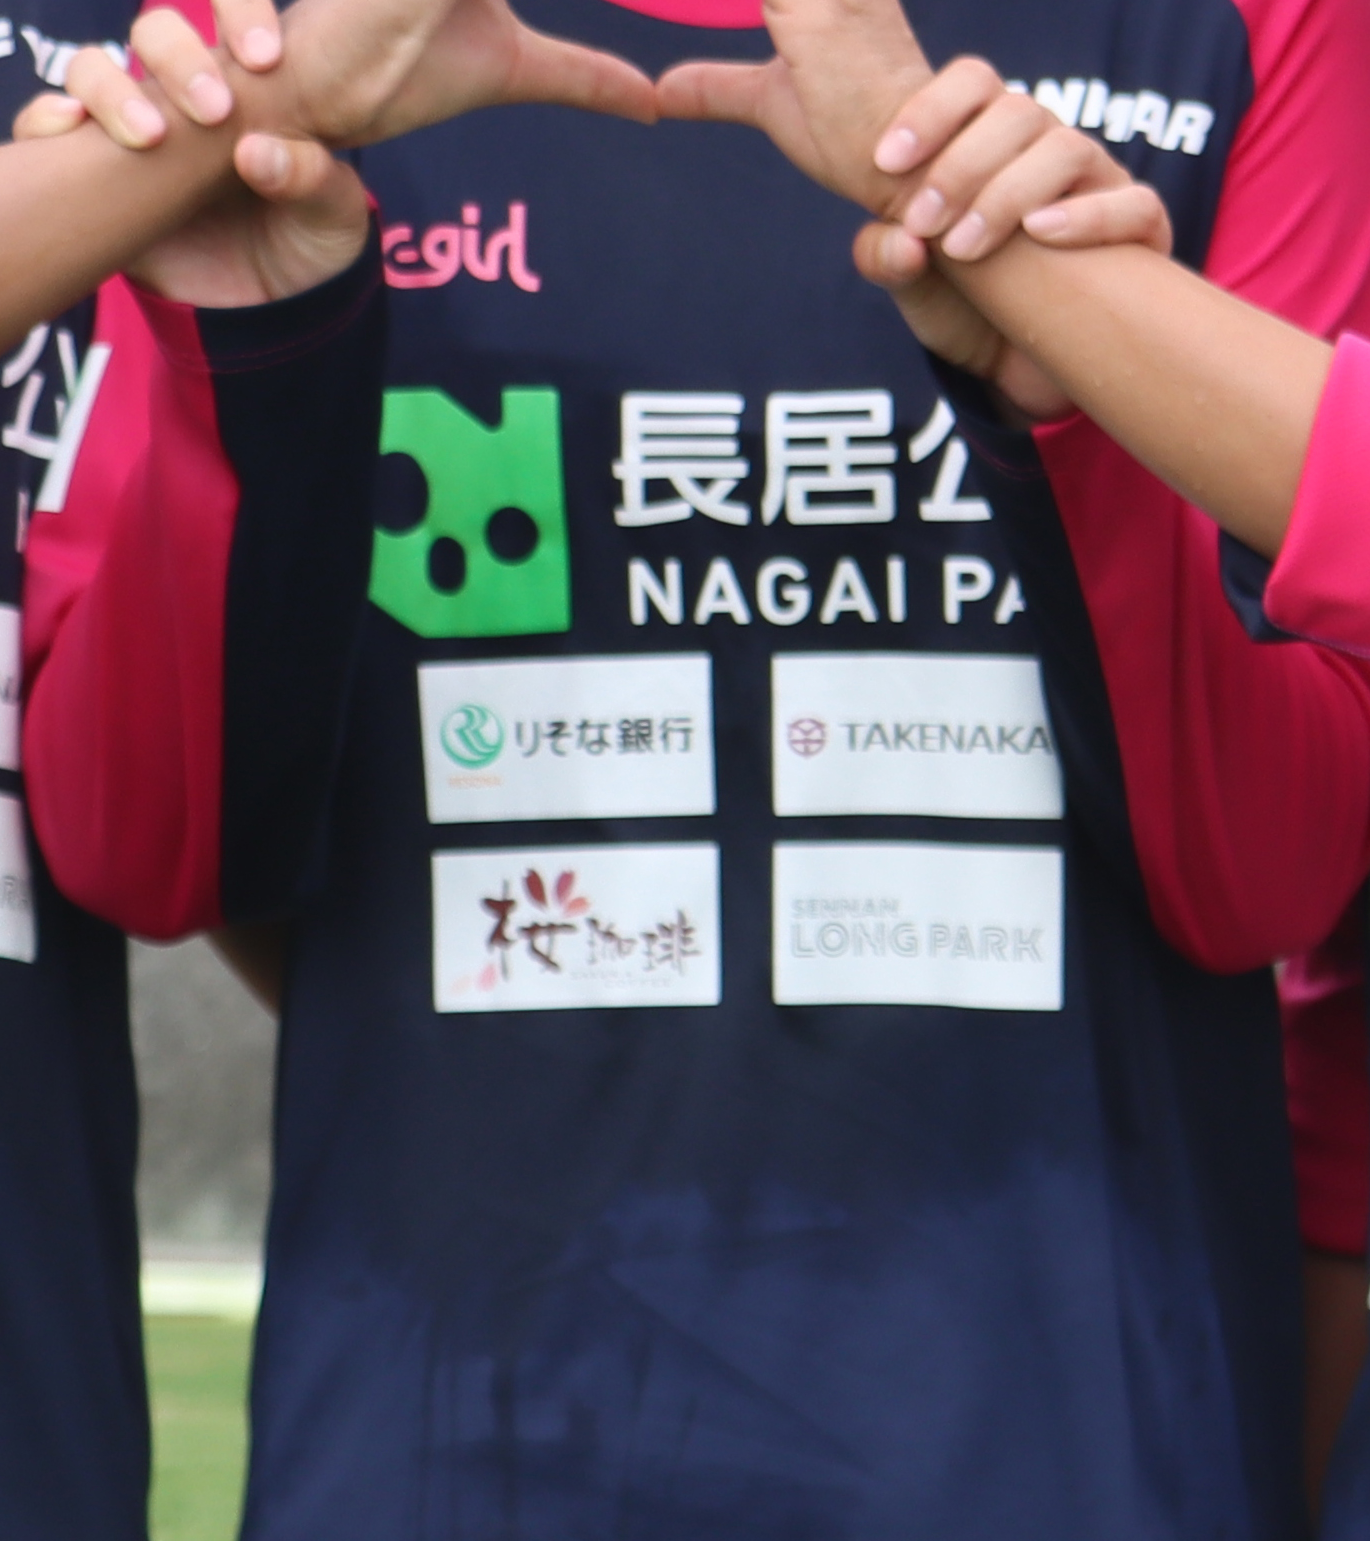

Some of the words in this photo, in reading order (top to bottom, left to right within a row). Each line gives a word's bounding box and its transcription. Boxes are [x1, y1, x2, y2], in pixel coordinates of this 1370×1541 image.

[1004, 79, 1215, 156] NMAR
[628, 555, 908, 627] NAGAI
[513, 717, 695, 758] りそな銀行
[838, 721, 1056, 757] TAKENAKA
[789, 921, 919, 959] LONG
[928, 921, 1045, 963] PARK
